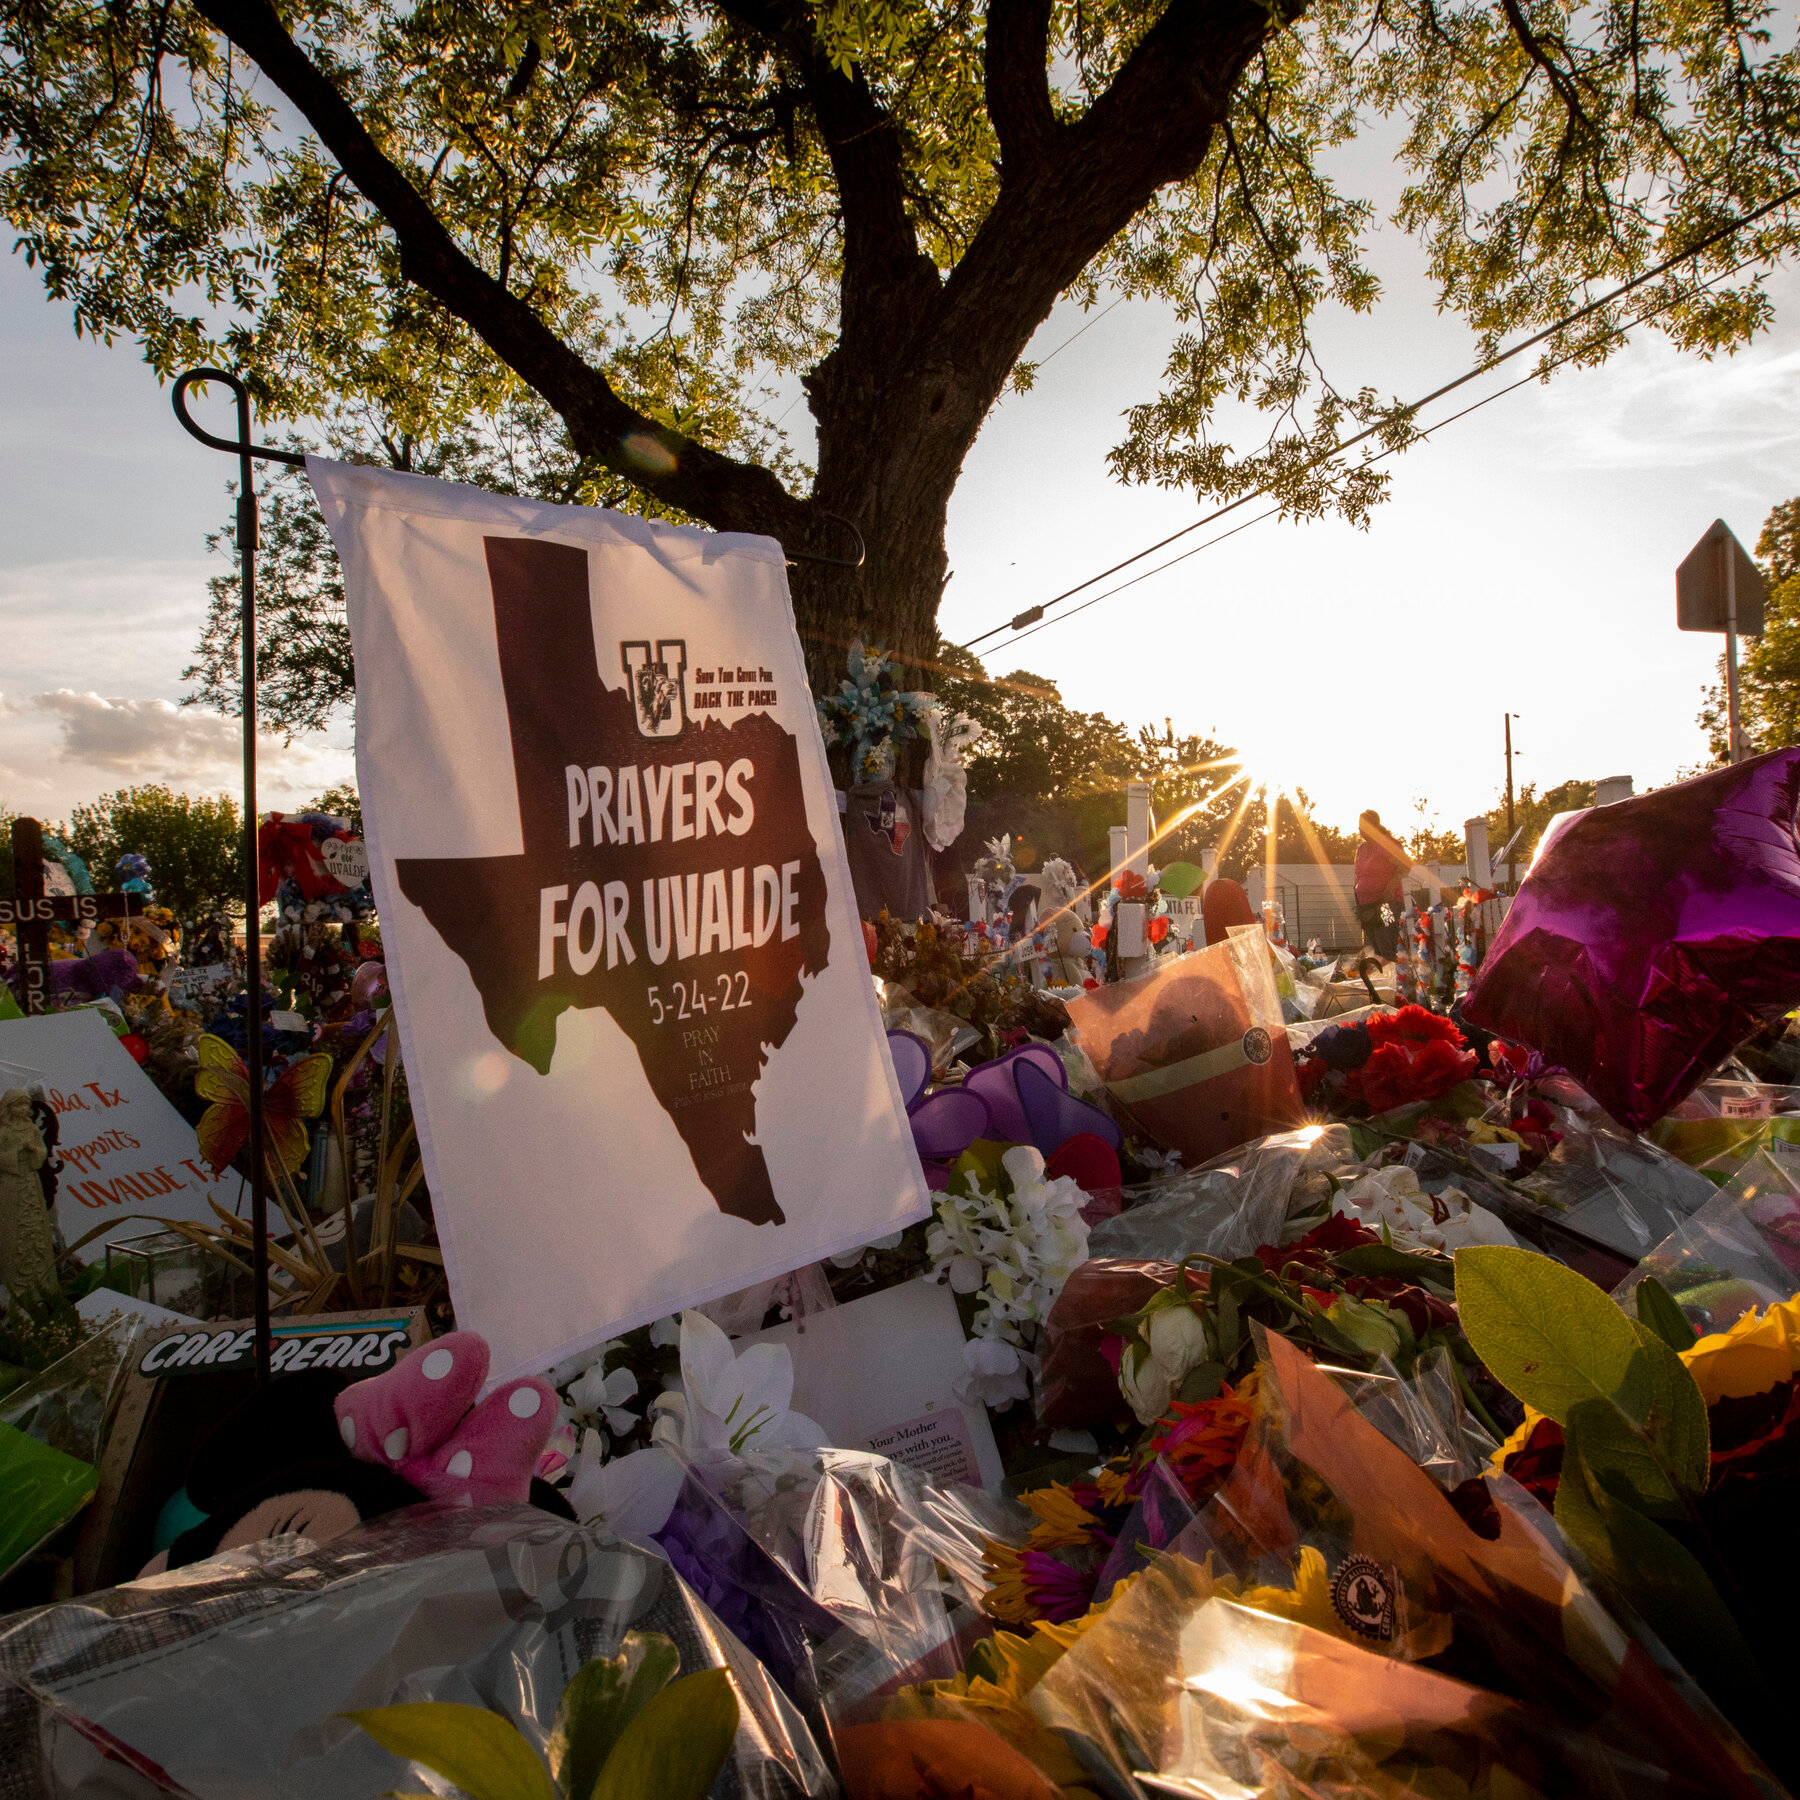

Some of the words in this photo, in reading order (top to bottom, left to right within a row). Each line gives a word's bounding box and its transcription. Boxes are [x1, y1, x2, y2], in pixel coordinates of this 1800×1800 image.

[620, 639, 687, 743] U
[694, 691, 722, 709] BACK
[727, 690, 744, 707] THE
[565, 758, 755, 848] PRAYERS
[329, 862, 366, 877] UVALDE
[73, 896, 98, 919] IS
[1185, 901, 1196, 915] FE
[538, 880, 636, 981] FOR
[643, 859, 800, 966] UVALDE
[648, 971, 752, 1024] 5-24-22
[682, 1025, 720, 1048] PRAY
[698, 1047, 714, 1067] IN
[688, 1064, 731, 1090] FAITH
[140, 1329, 257, 1372] CARE
[270, 1331, 406, 1373] BEARS
[868, 1436, 896, 1450] Your
[896, 1420, 938, 1442] Mother
[905, 1439, 929, 1454] with
[930, 1433, 954, 1450] you.
